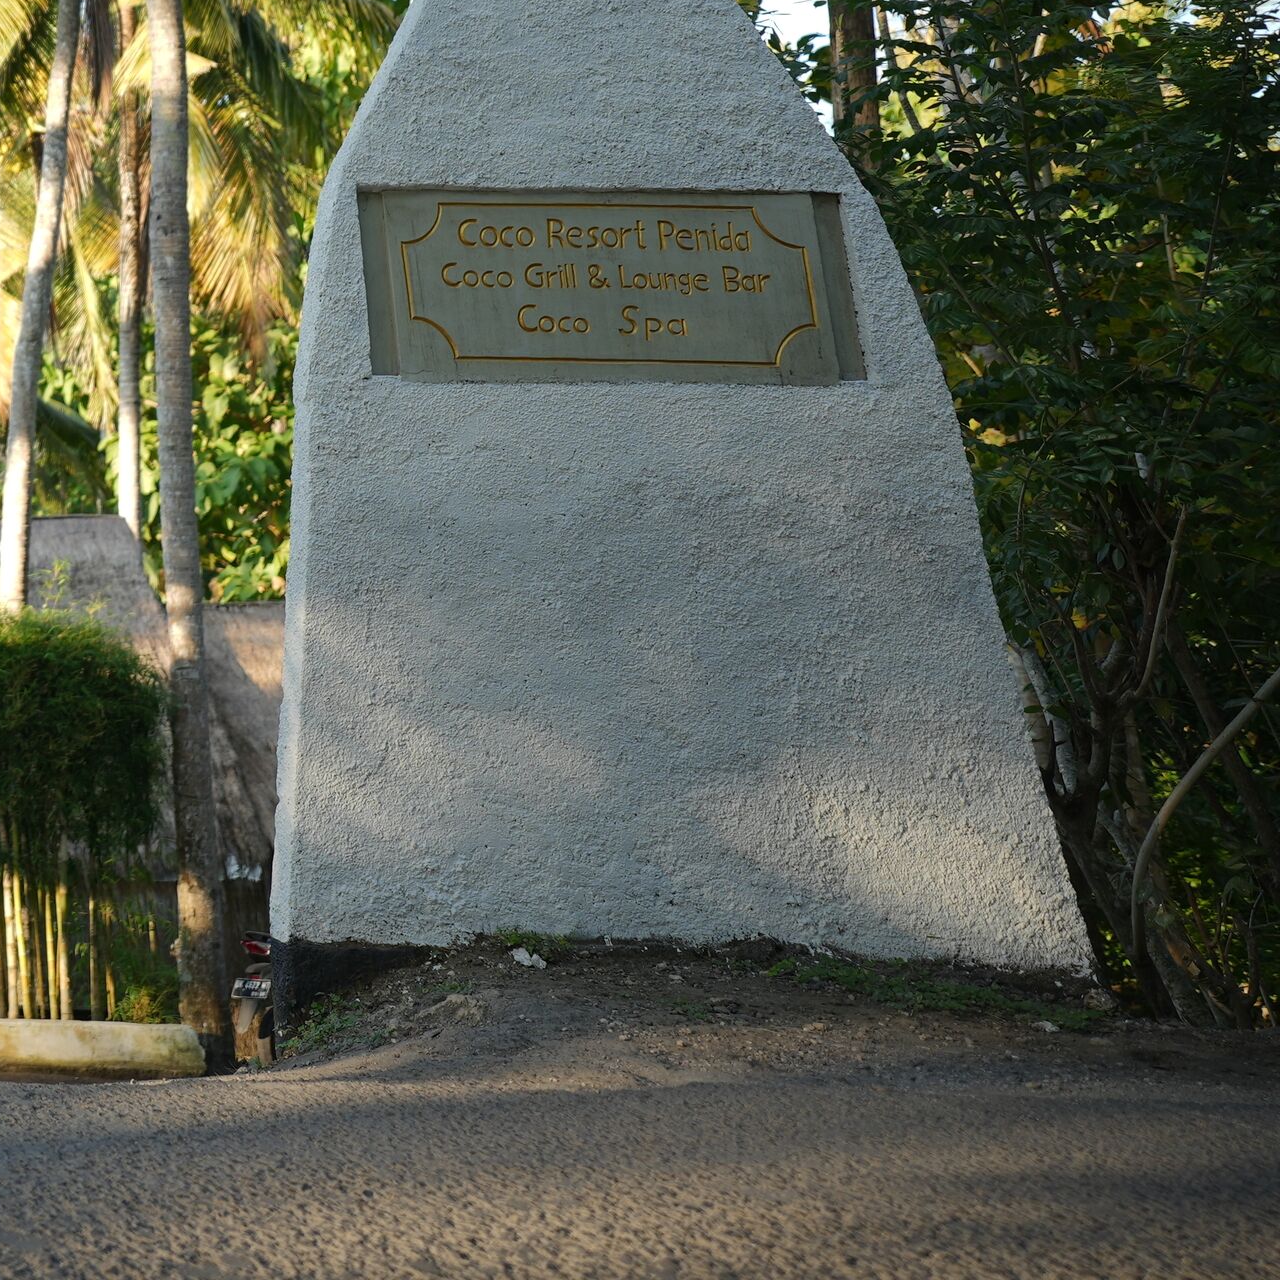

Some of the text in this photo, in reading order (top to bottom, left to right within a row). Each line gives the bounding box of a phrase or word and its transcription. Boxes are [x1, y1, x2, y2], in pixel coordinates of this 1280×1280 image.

[458, 218, 752, 252] Coco Resort Penida
[441, 262, 771, 296] Coco Grill & Lounge Bar
[517, 304, 688, 341] Coco Spa
